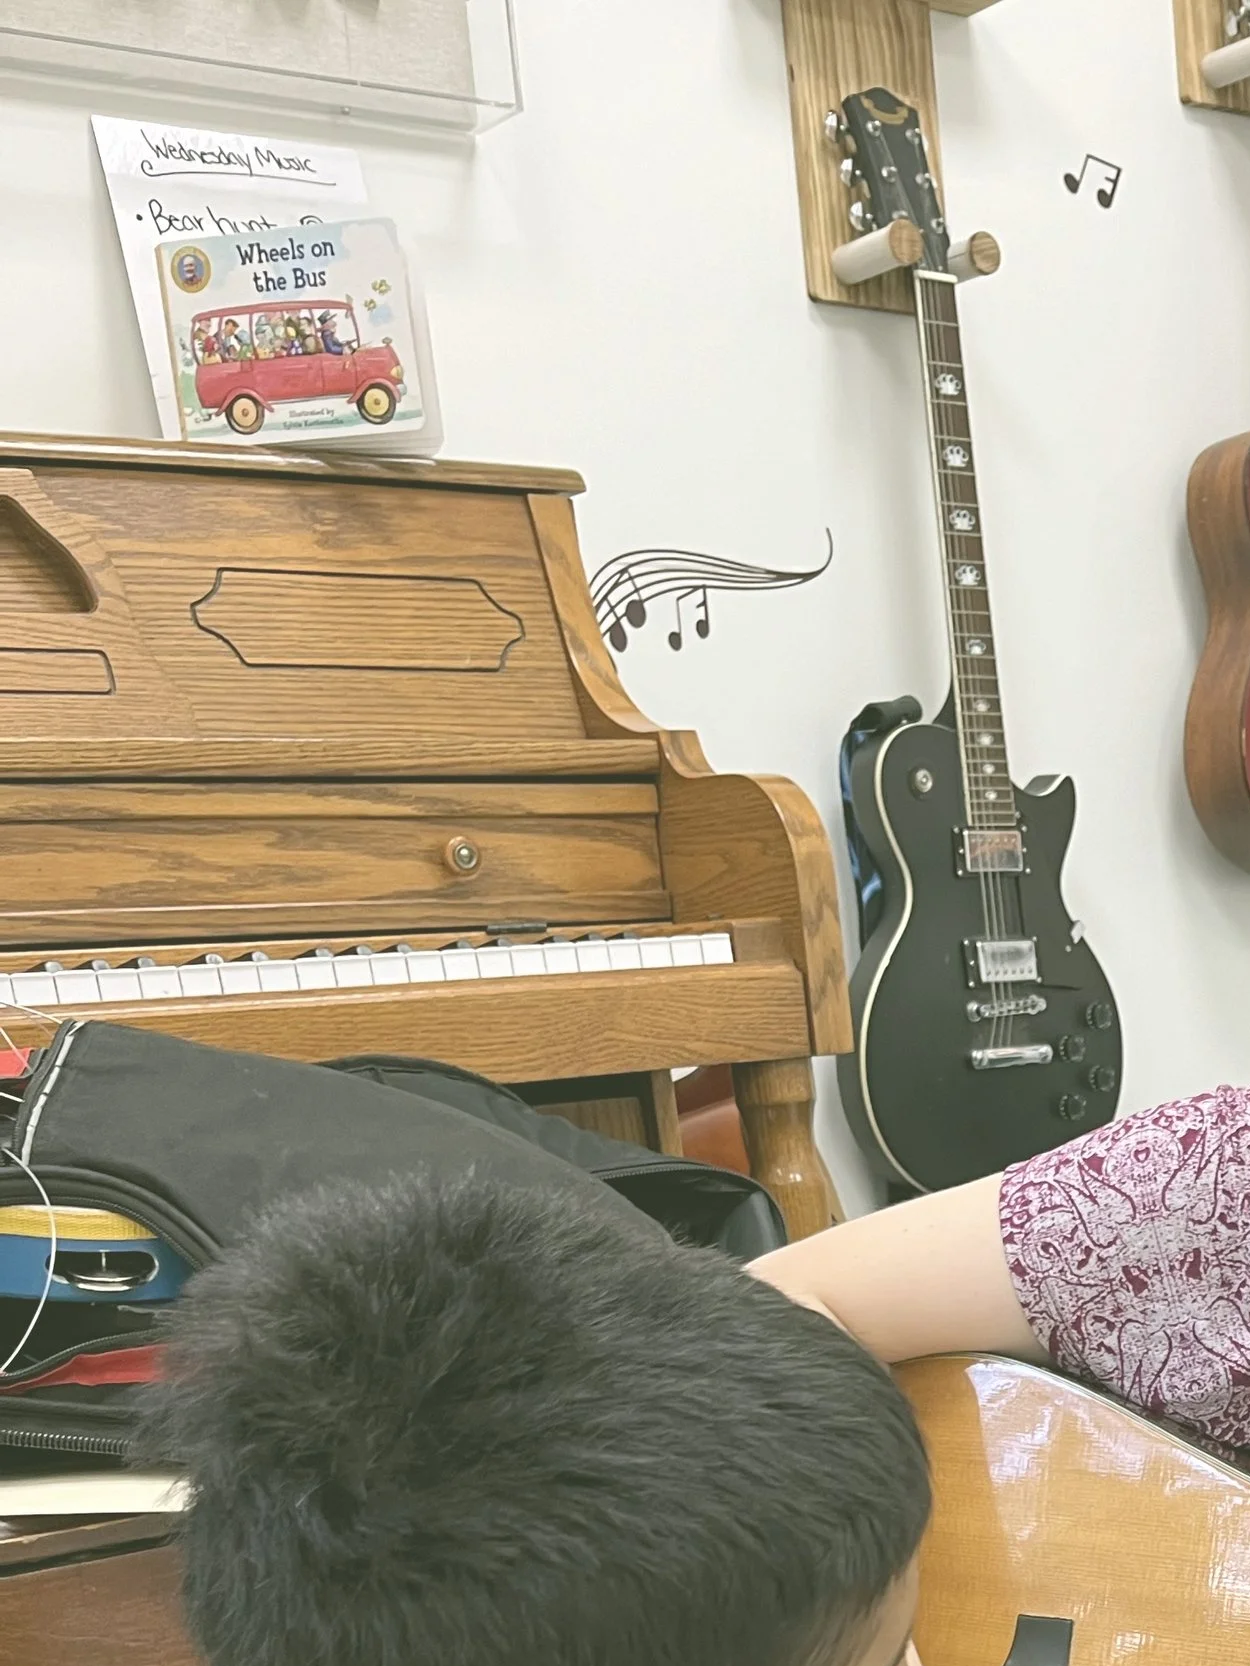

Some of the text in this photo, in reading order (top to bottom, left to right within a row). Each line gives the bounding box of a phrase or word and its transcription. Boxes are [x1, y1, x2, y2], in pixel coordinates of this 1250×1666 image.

[140, 128, 317, 177] Wednesday Music
[148, 198, 204, 235] Bear
[236, 237, 335, 266] Wheels on
[253, 267, 327, 293] the Bus
